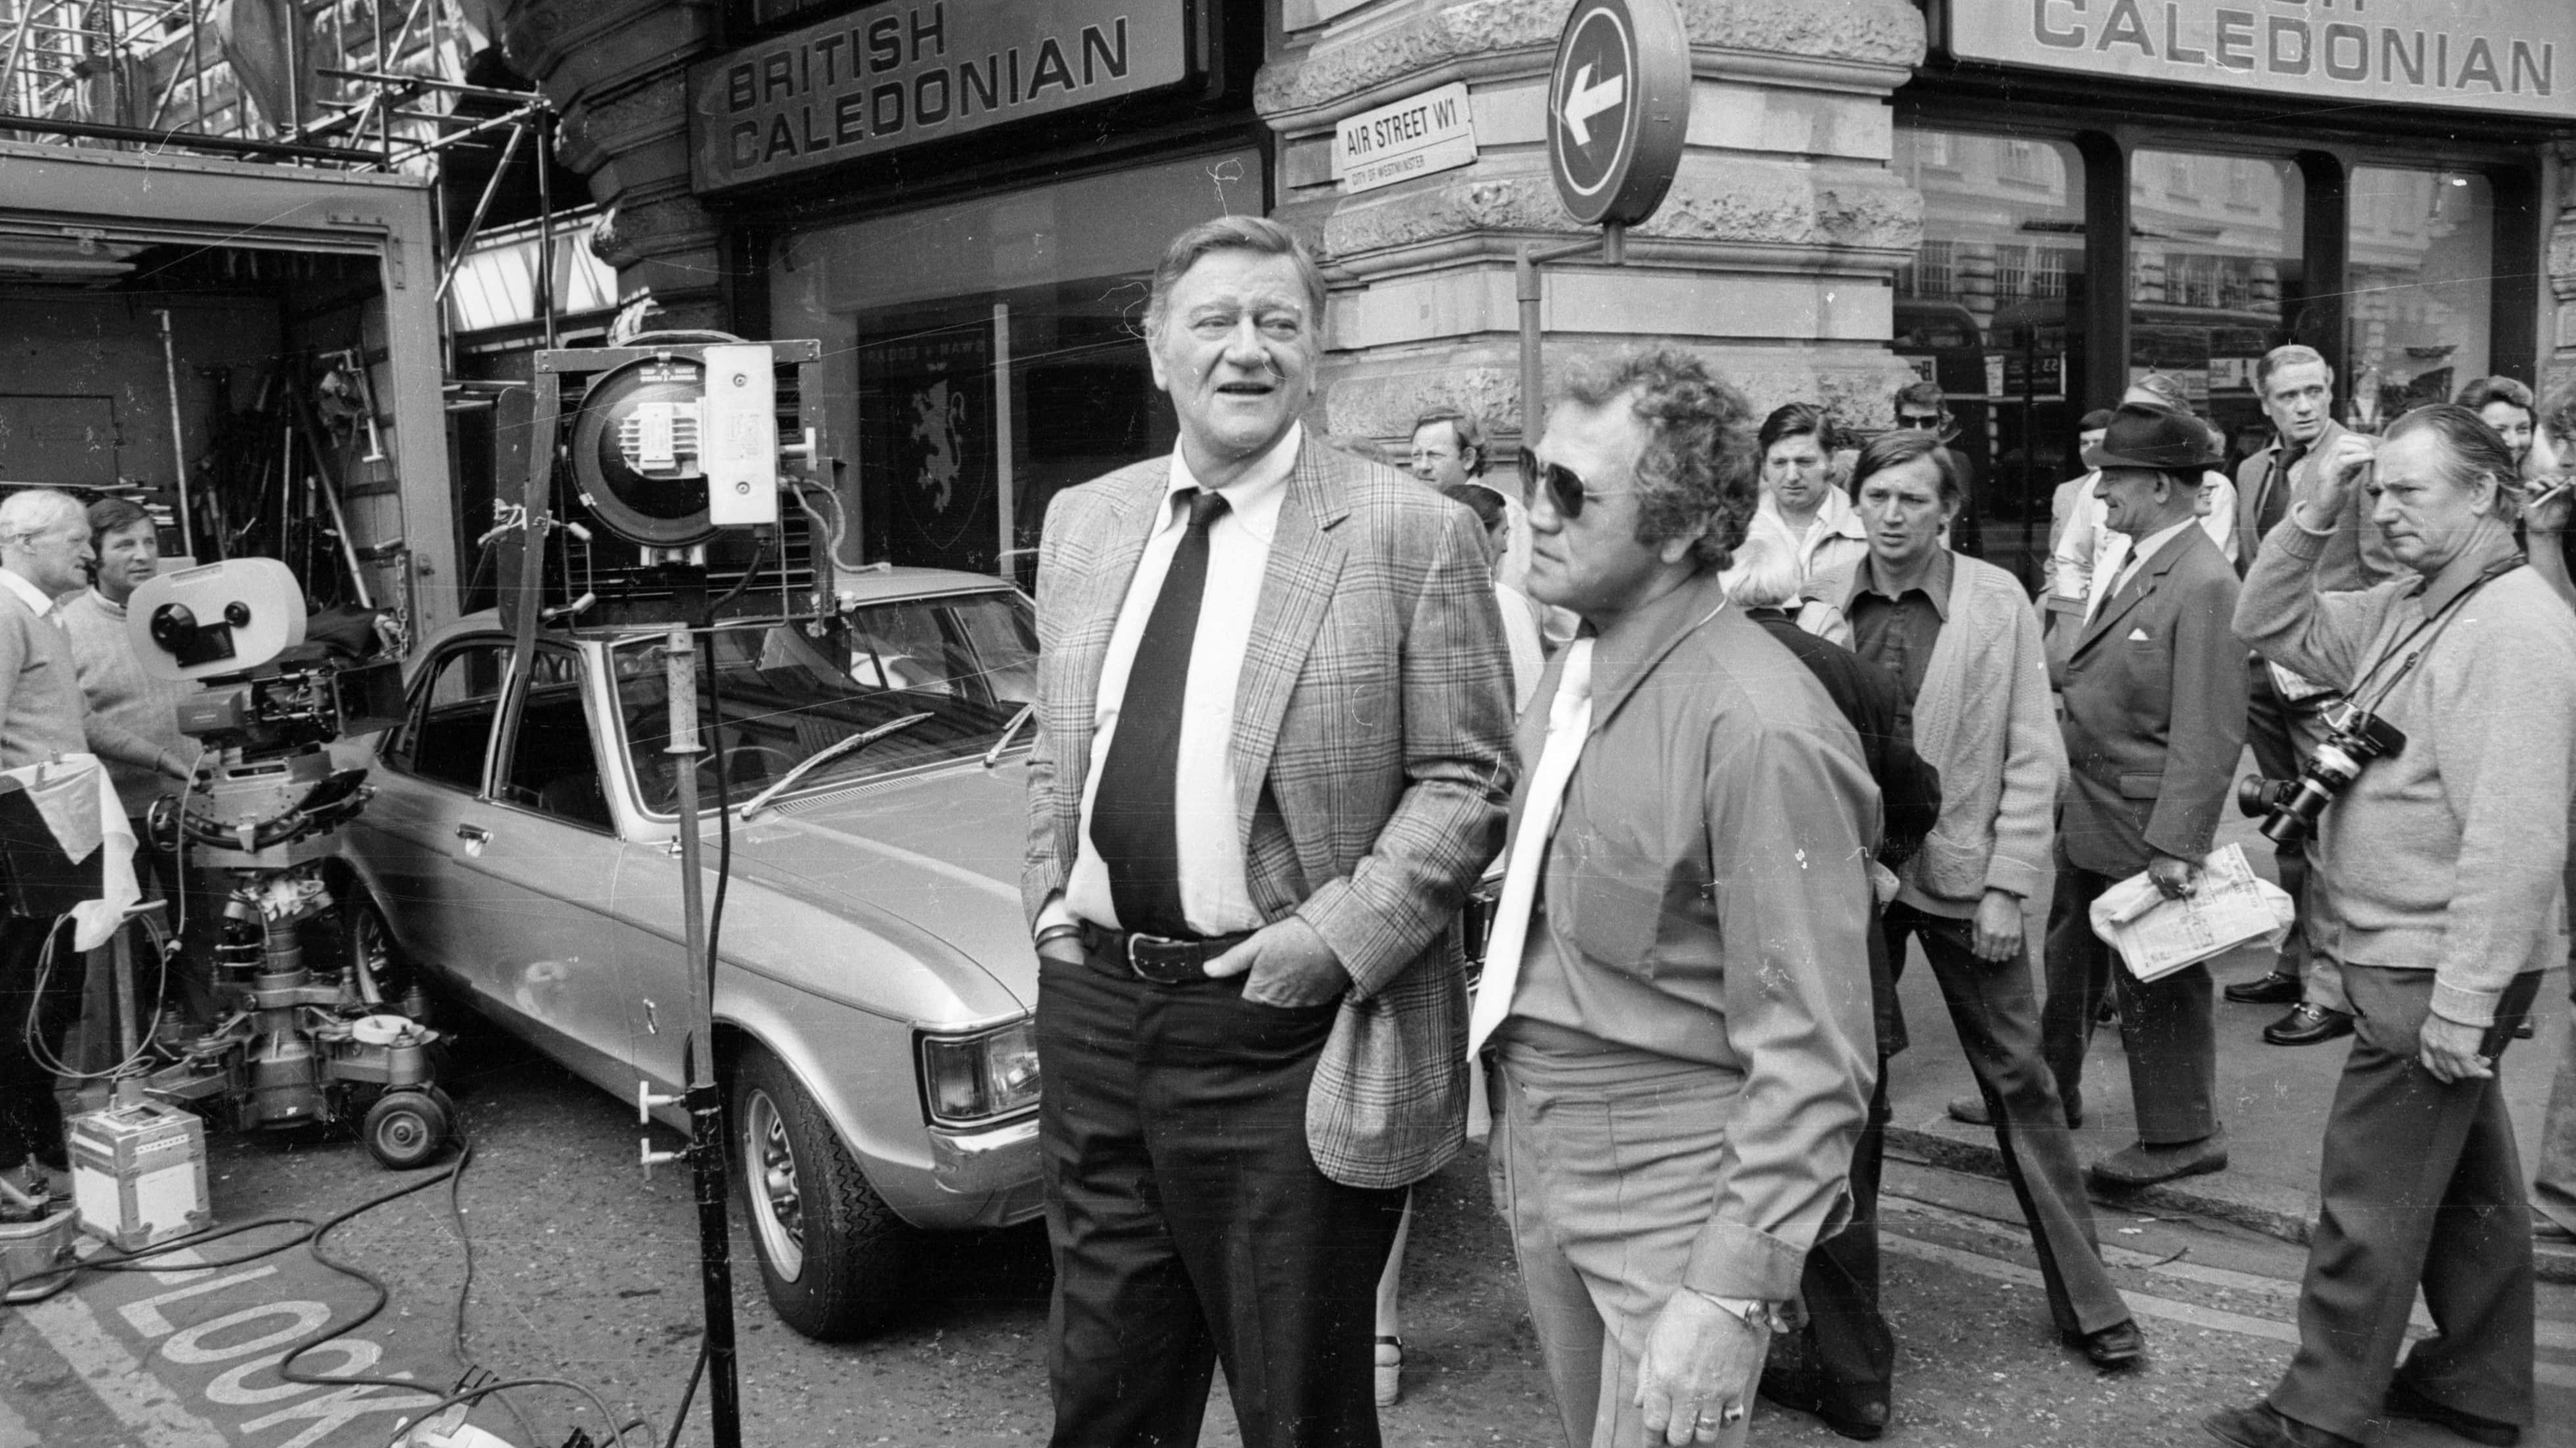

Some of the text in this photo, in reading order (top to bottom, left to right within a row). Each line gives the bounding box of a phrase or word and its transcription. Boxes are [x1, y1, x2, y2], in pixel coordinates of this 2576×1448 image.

[728, 1, 945, 114] BRITISH
[730, 16, 1128, 171] CALEDONIAN
[2034, 0, 2553, 97] CALEDONIAN
[1347, 97, 1457, 156] AIR STREET W1
[1352, 172, 1366, 186] CITY
[1378, 154, 1425, 177] WESTMINSTER
[116, 1265, 444, 1448] LOOK
